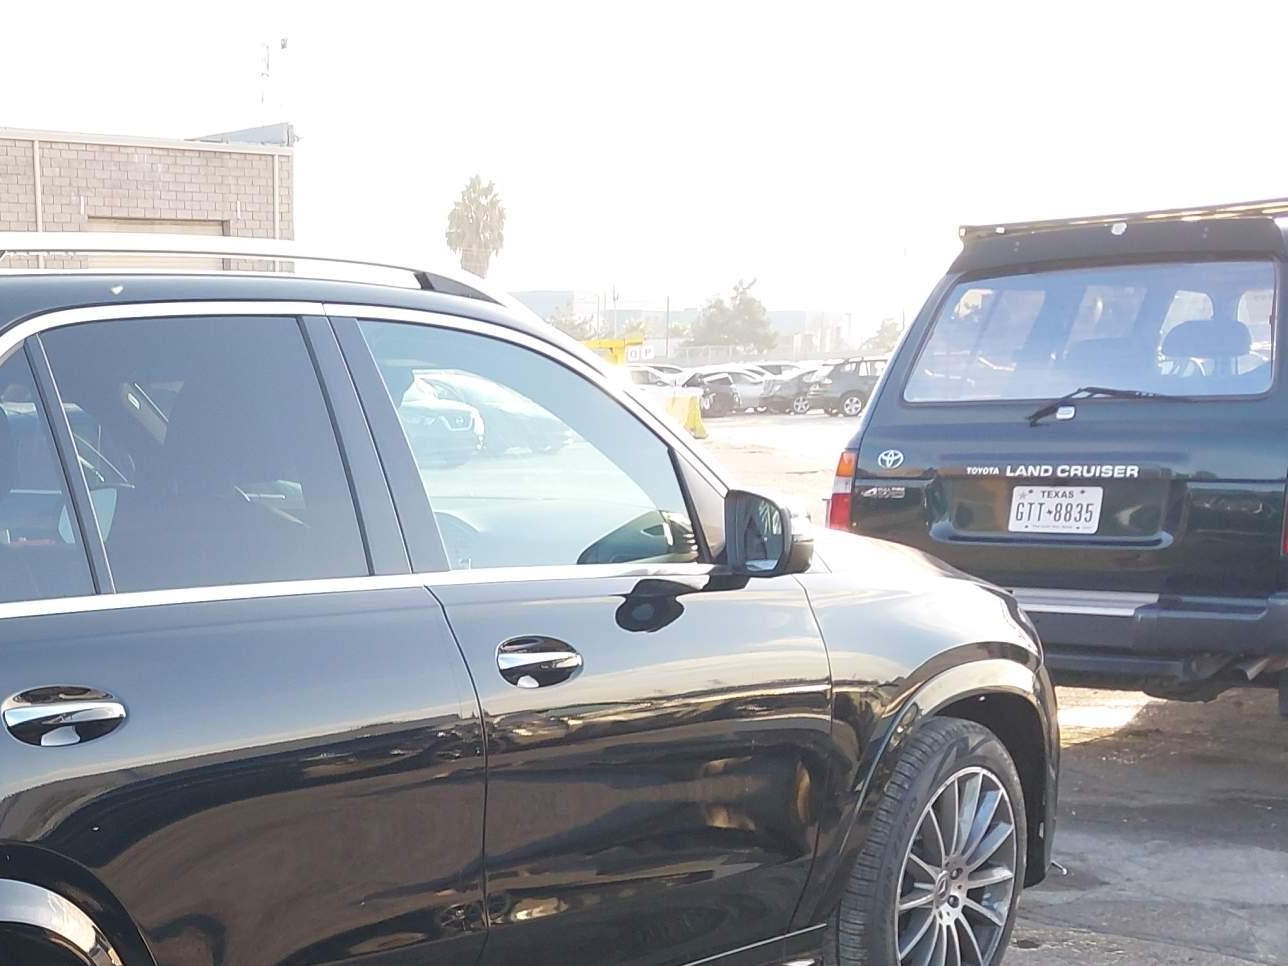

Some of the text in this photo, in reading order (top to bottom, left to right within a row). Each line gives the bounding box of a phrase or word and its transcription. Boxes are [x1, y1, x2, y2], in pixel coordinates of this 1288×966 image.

[966, 465, 1140, 479] TOYOTA LAND CRUISER
[1040, 490, 1075, 499] TEXAS
